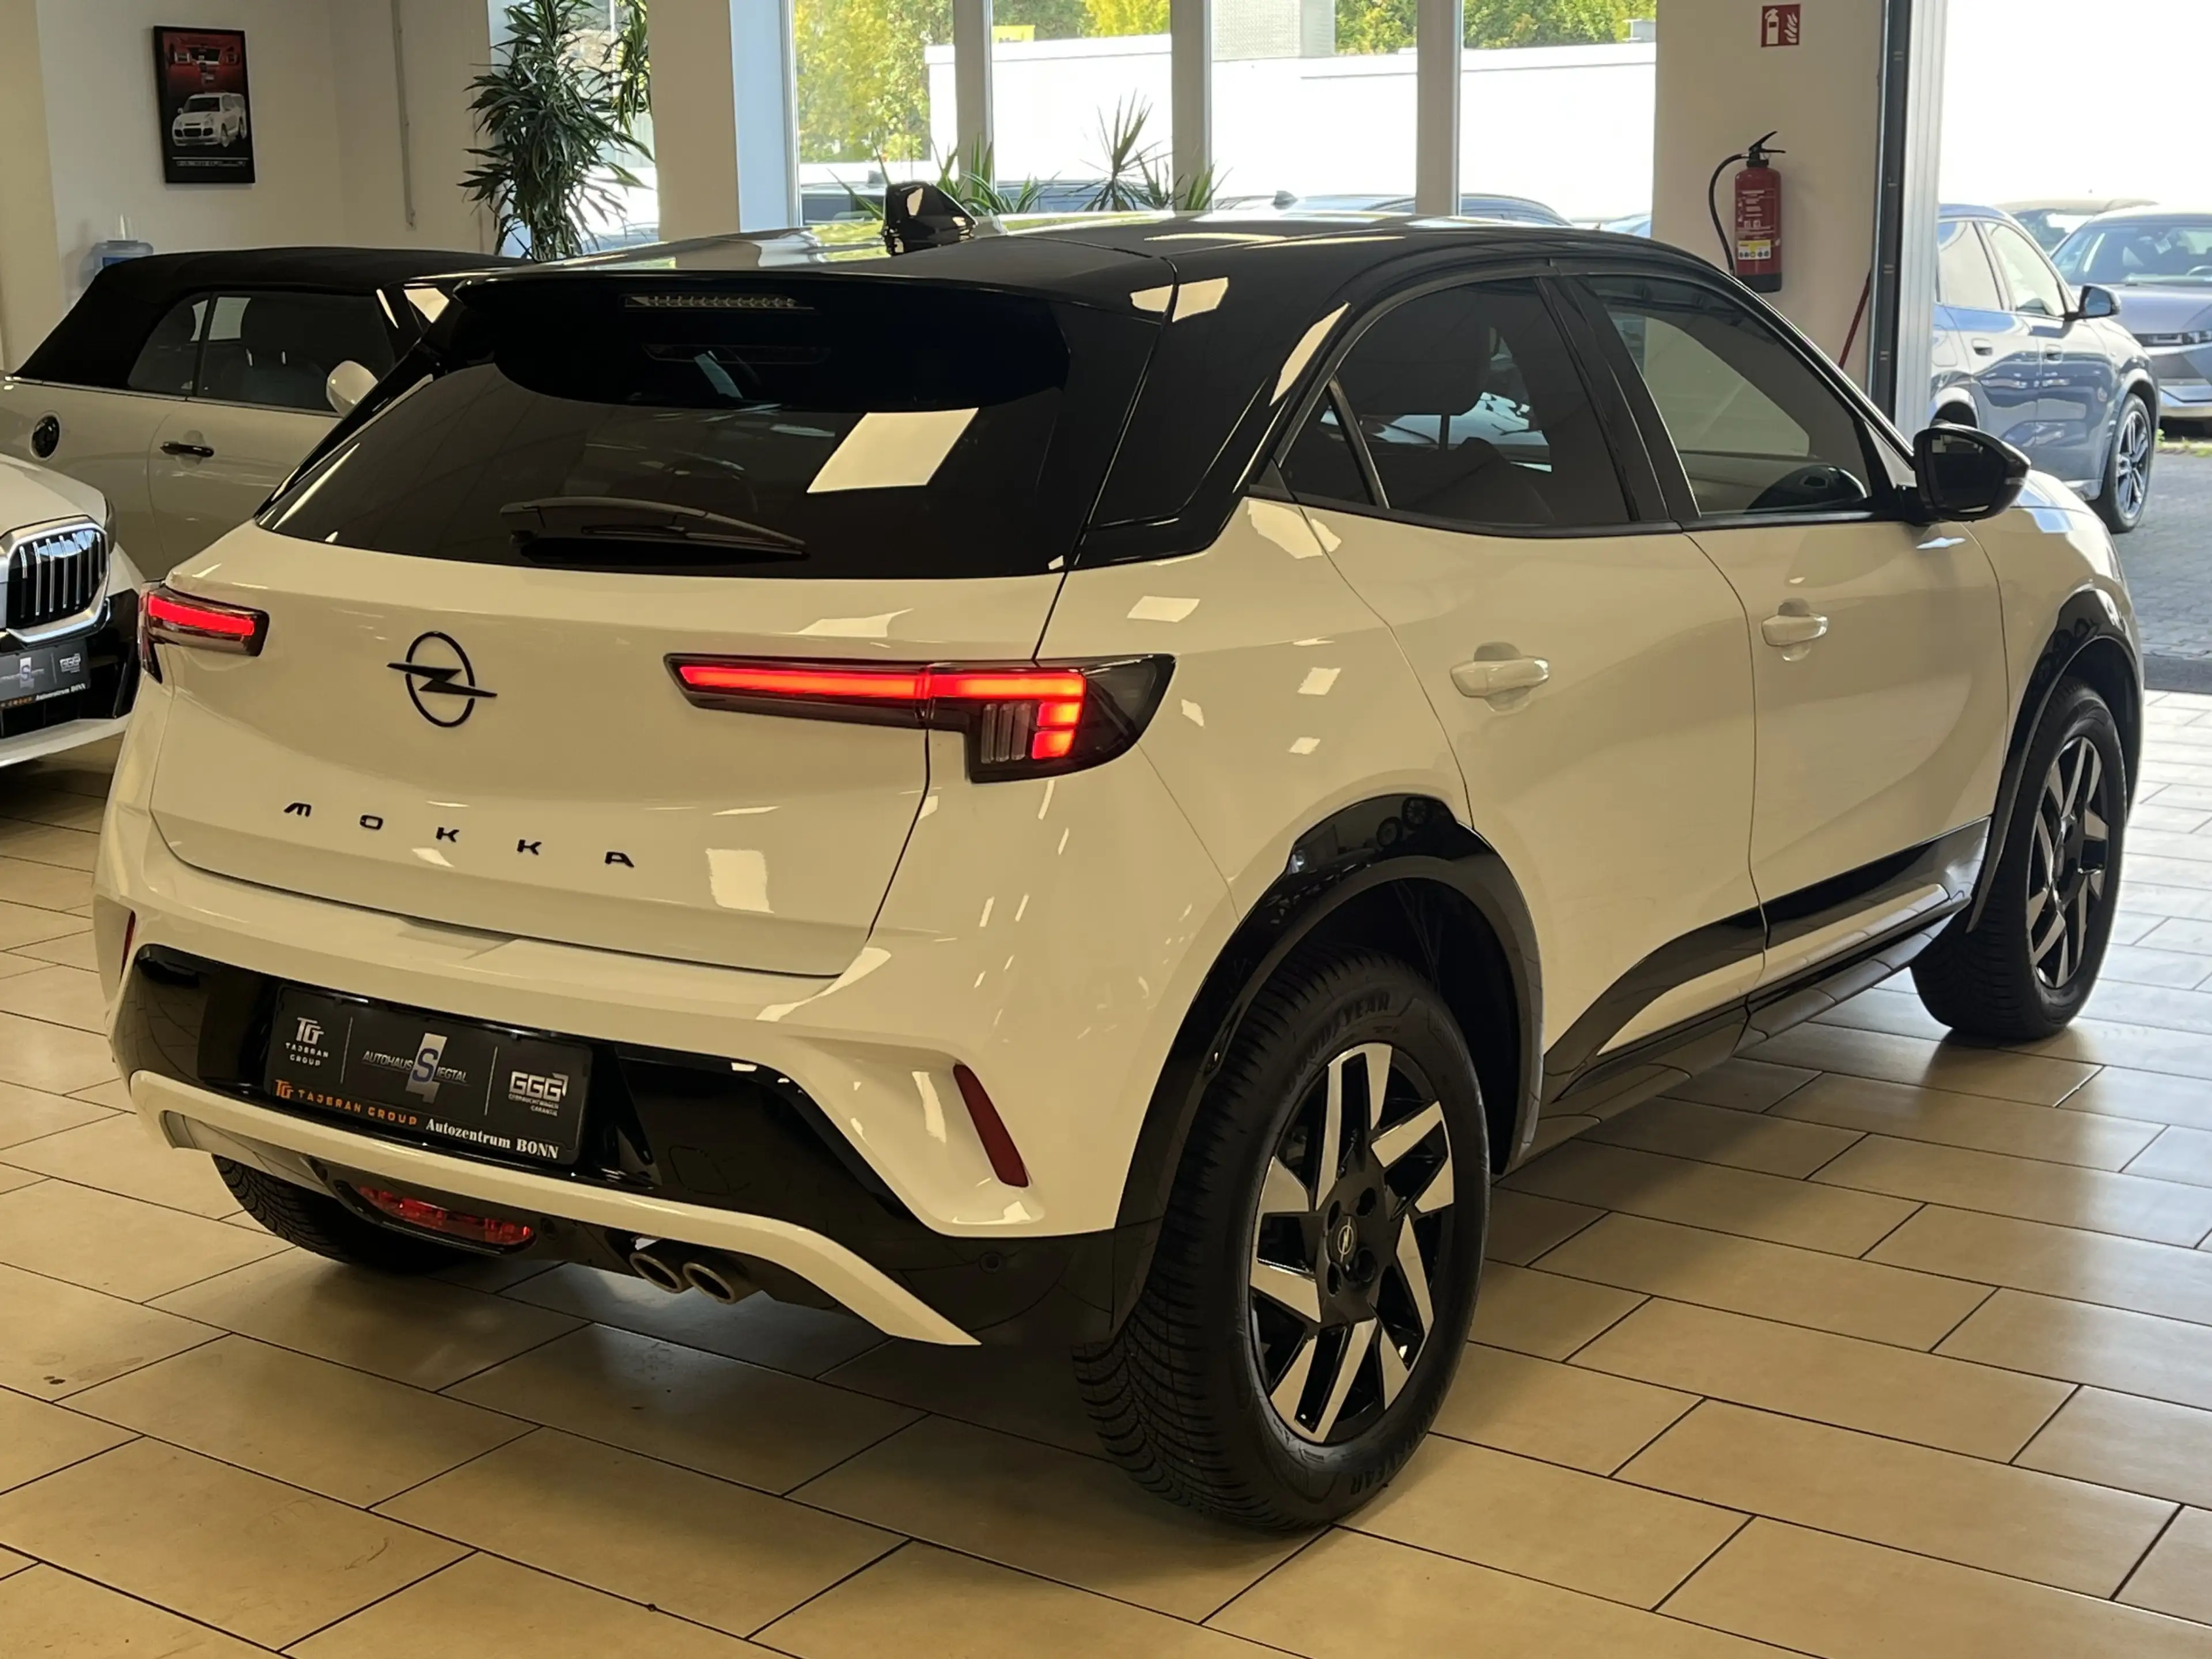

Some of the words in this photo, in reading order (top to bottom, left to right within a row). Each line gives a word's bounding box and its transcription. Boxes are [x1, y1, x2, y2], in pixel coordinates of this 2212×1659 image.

[283, 801, 635, 869] MOKKA
[285, 1042, 329, 1058] TAJERAN
[289, 1054, 321, 1066] GROUP
[362, 1050, 414, 1070] AUTOHAUS
[509, 1071, 565, 1102] GGG
[298, 1089, 362, 1113] TAJERAN
[367, 1107, 418, 1126] GROUP
[425, 1118, 511, 1149] Autozentrum
[516, 1138, 559, 1159] BONN
